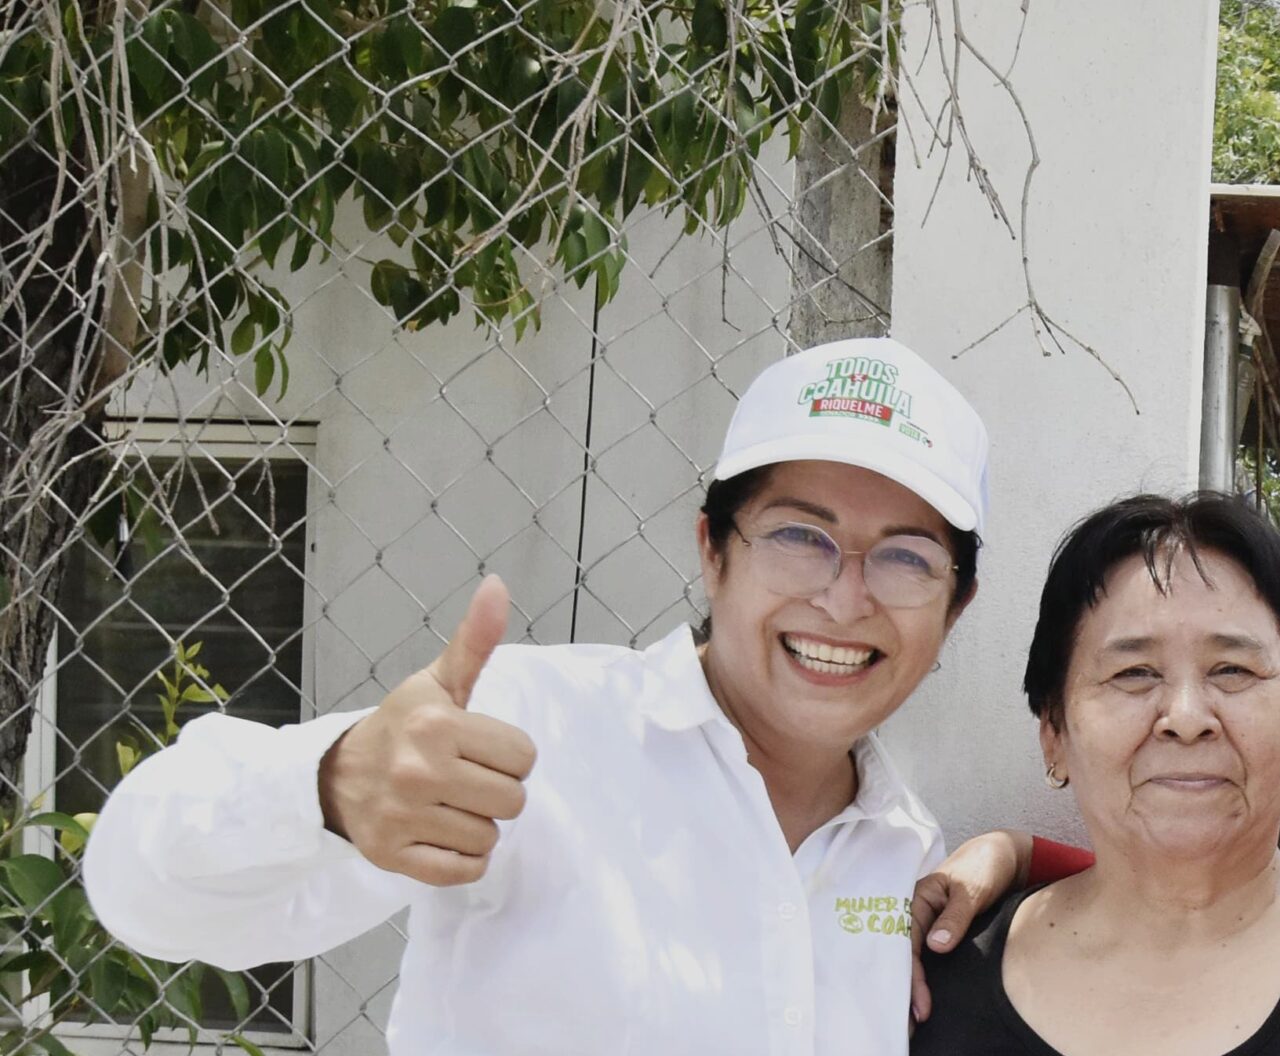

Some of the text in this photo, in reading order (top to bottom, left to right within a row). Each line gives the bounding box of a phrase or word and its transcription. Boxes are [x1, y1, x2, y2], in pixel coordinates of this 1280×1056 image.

[826, 357, 899, 385] TODOS
[797, 377, 912, 419] COAHUILA
[819, 399, 884, 418] RIQUELME
[834, 896, 898, 913] MUJER
